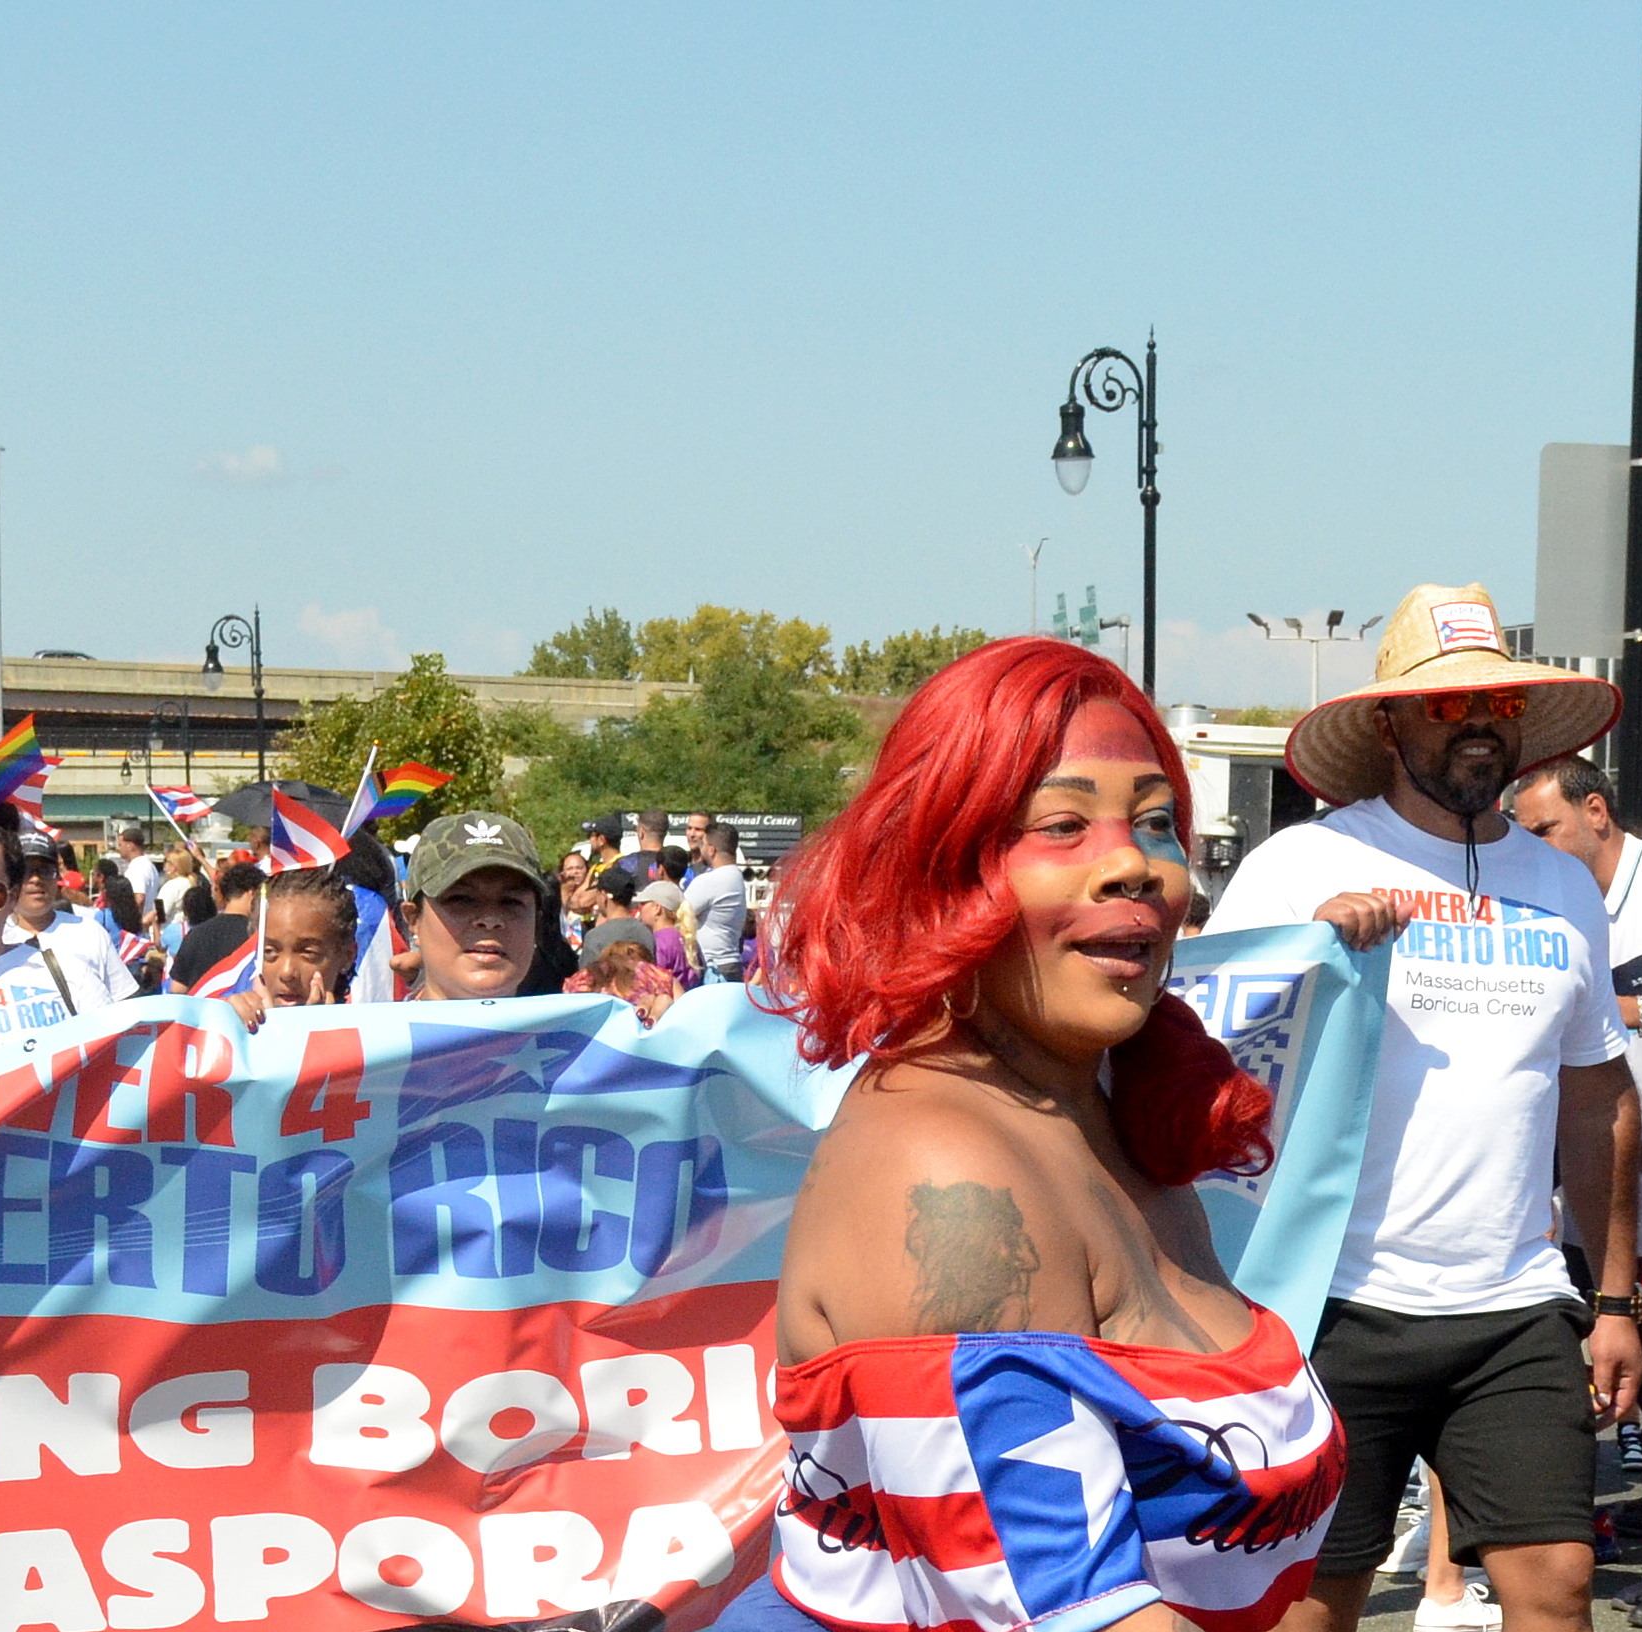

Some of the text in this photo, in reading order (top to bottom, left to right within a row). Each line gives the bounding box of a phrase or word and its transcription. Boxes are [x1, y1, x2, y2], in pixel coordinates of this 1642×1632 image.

[763, 815, 798, 826] Center
[465, 837, 504, 845] adidas
[1476, 895, 1496, 925] 4
[1395, 920, 1571, 971] UERTO RICO
[1406, 970, 1546, 995] Massachusetts
[15, 1000, 66, 1030] RICO
[1410, 993, 1537, 1017] Boricua Crew
[279, 1027, 371, 1144] 4
[388, 1117, 730, 1280] RICO
[309, 1344, 777, 1474] BORI
